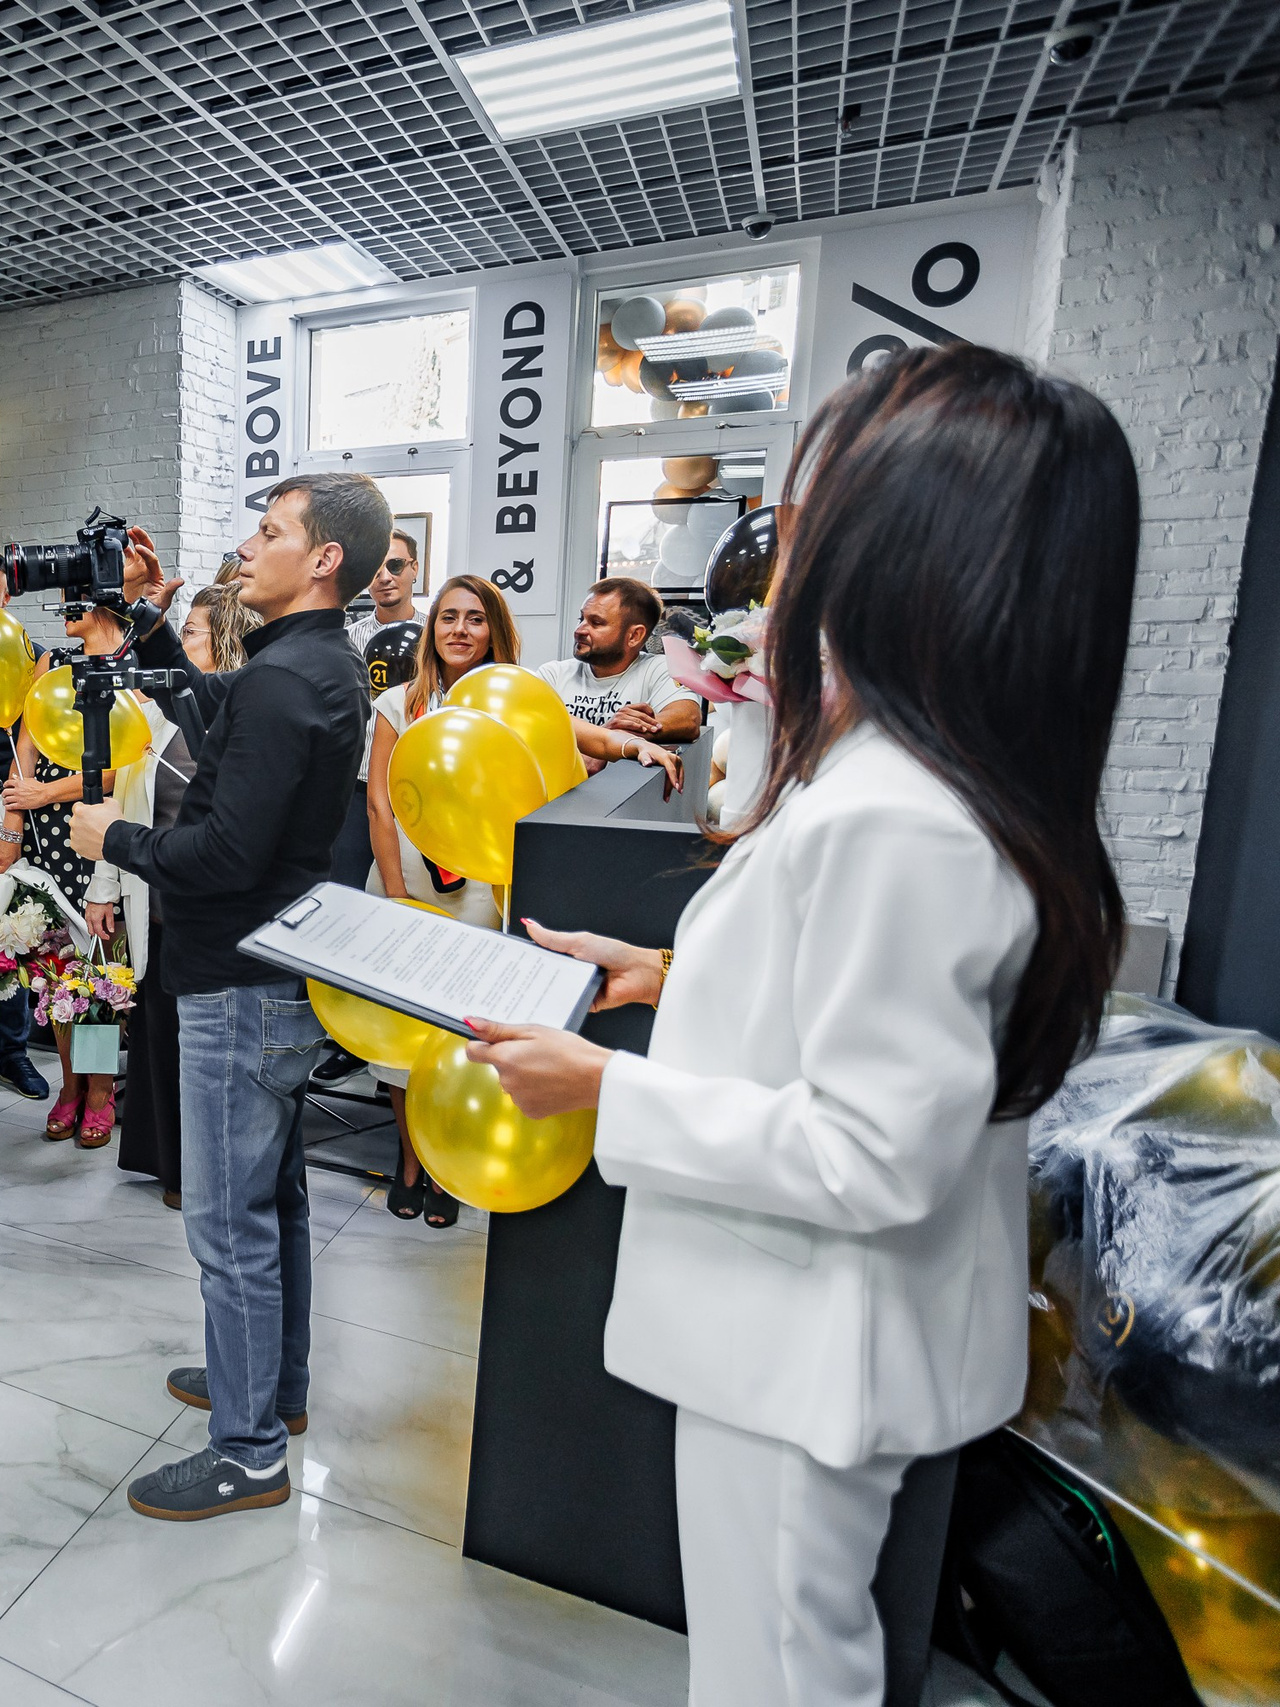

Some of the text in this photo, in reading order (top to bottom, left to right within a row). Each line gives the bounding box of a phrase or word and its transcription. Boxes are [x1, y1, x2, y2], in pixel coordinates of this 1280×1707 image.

[245, 336, 282, 513] ABOVE
[490, 301, 545, 594] & BEYOND
